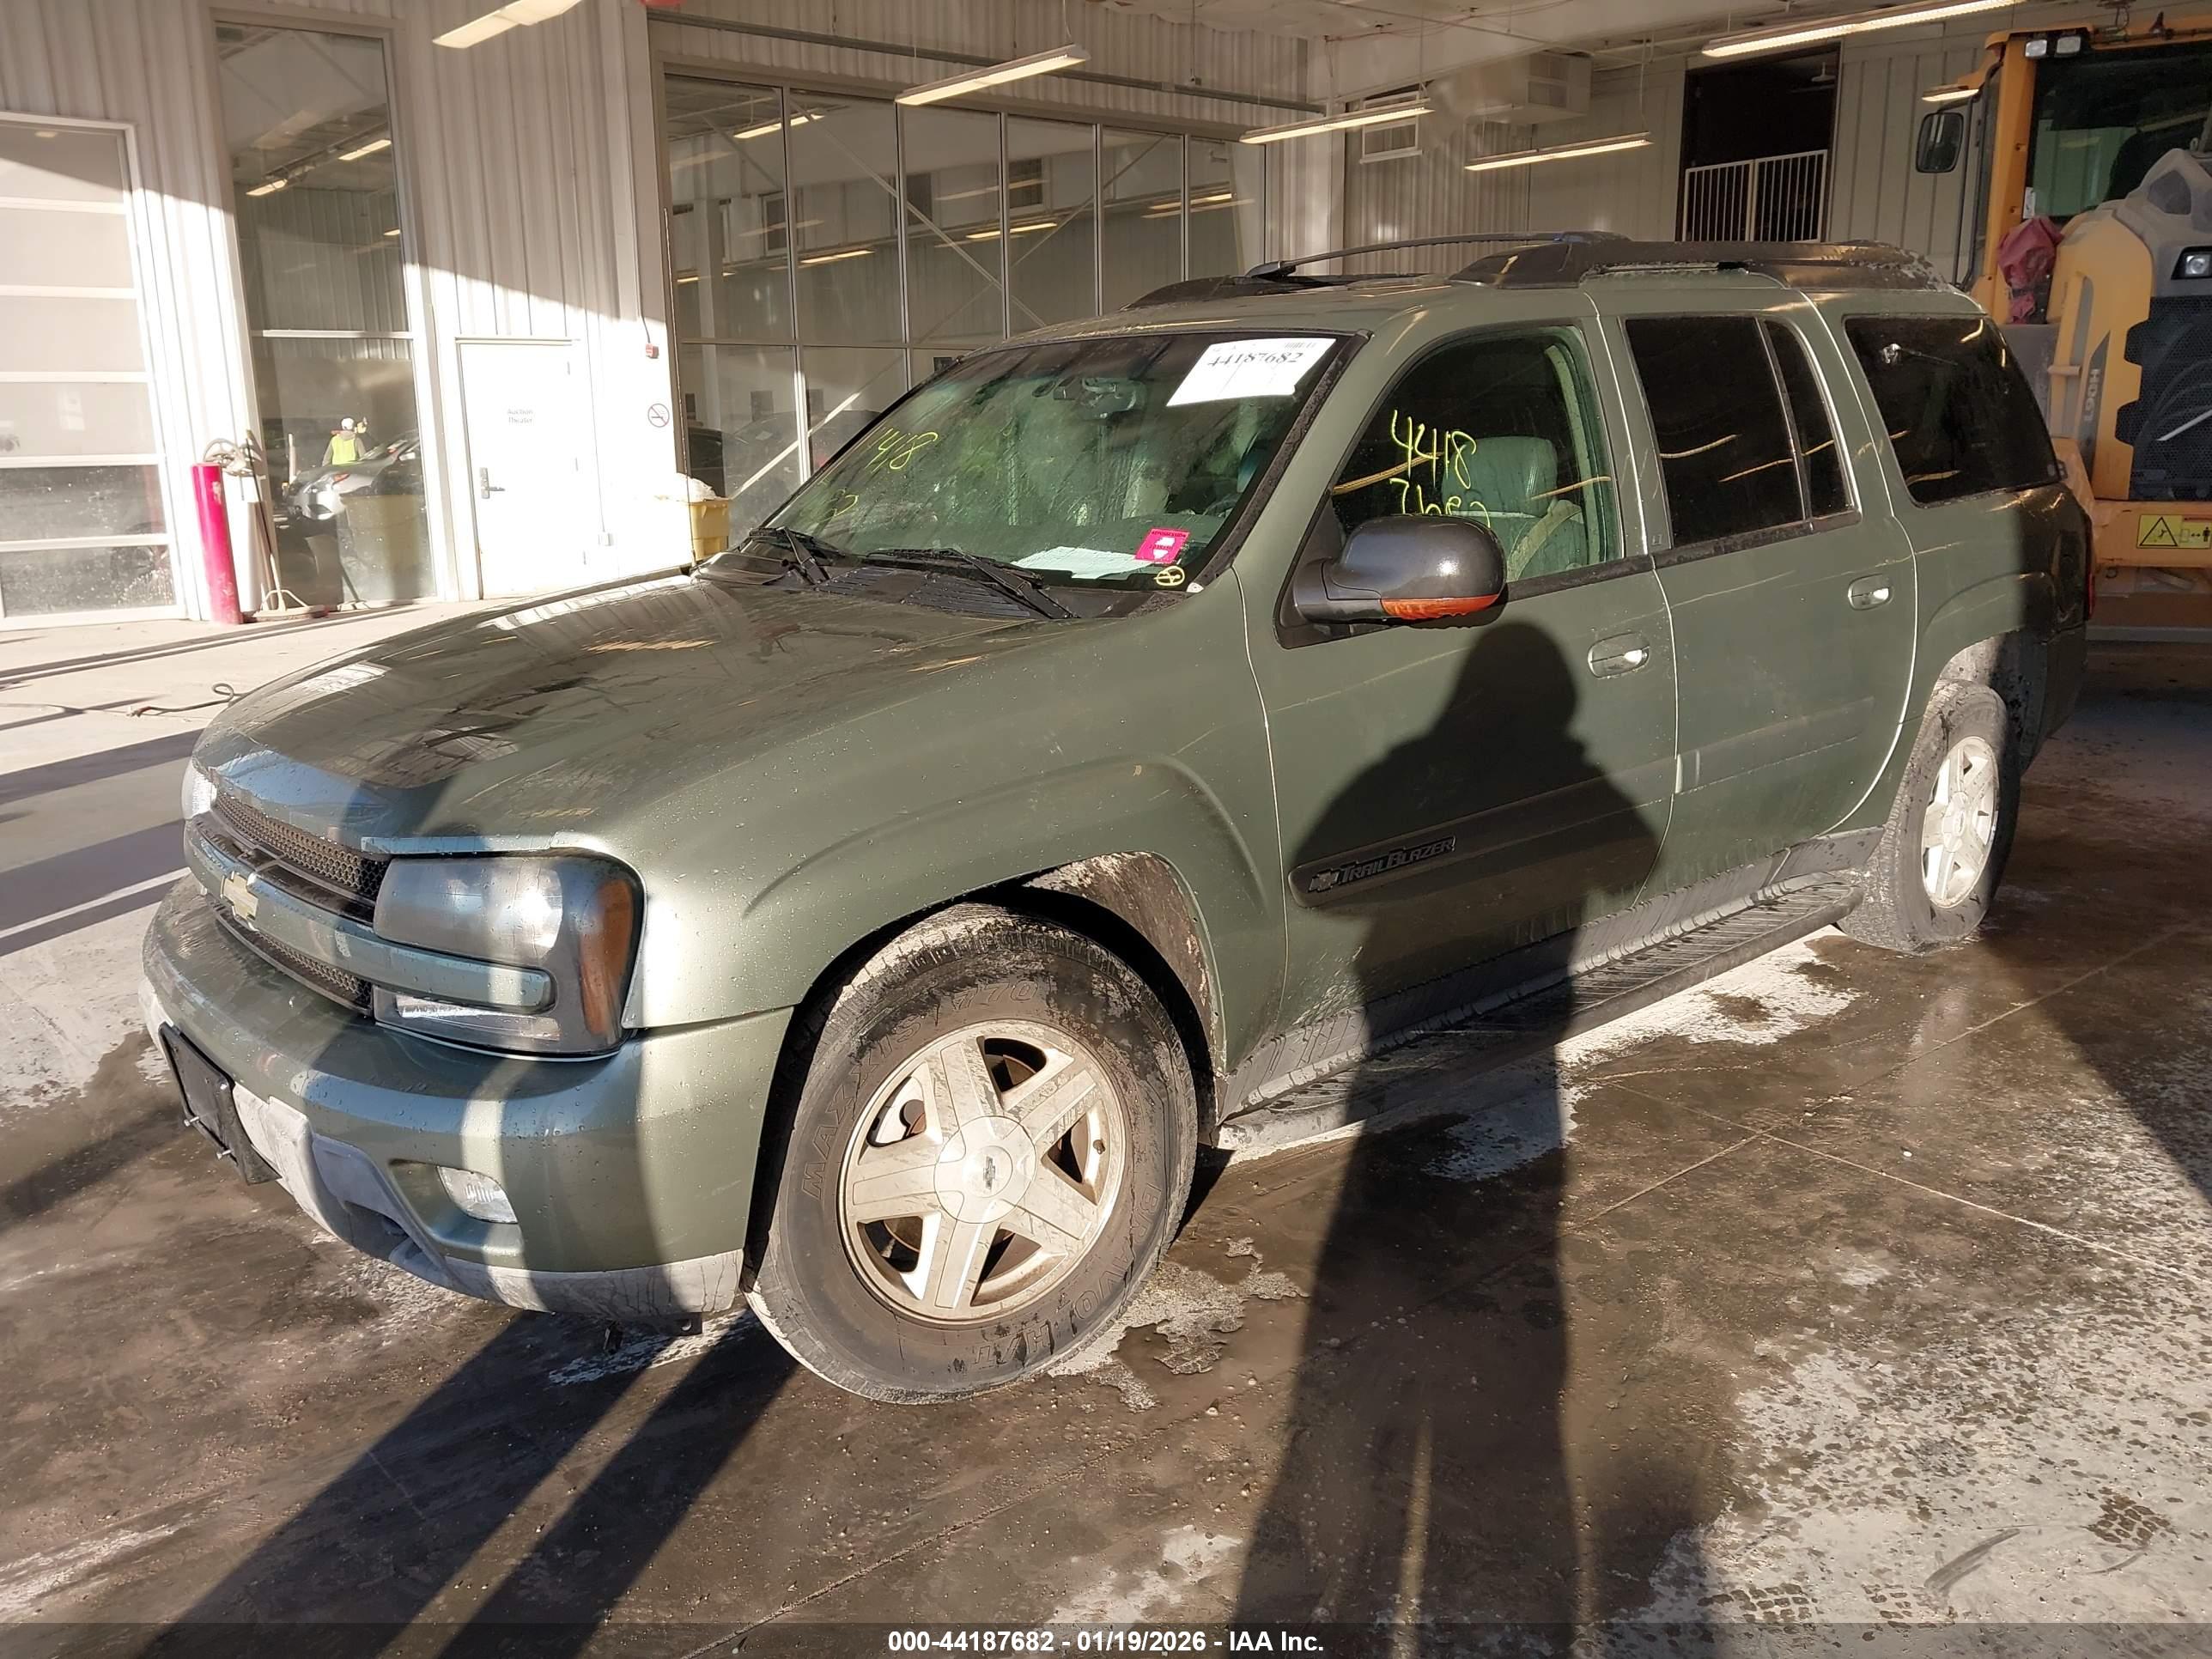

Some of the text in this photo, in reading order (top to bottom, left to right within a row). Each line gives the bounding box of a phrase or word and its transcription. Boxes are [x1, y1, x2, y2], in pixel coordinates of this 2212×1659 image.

[1207, 352, 1304, 368] 44187682
[1391, 410, 1477, 489] 4418
[800, 1014, 922, 1200] MAXXIS
